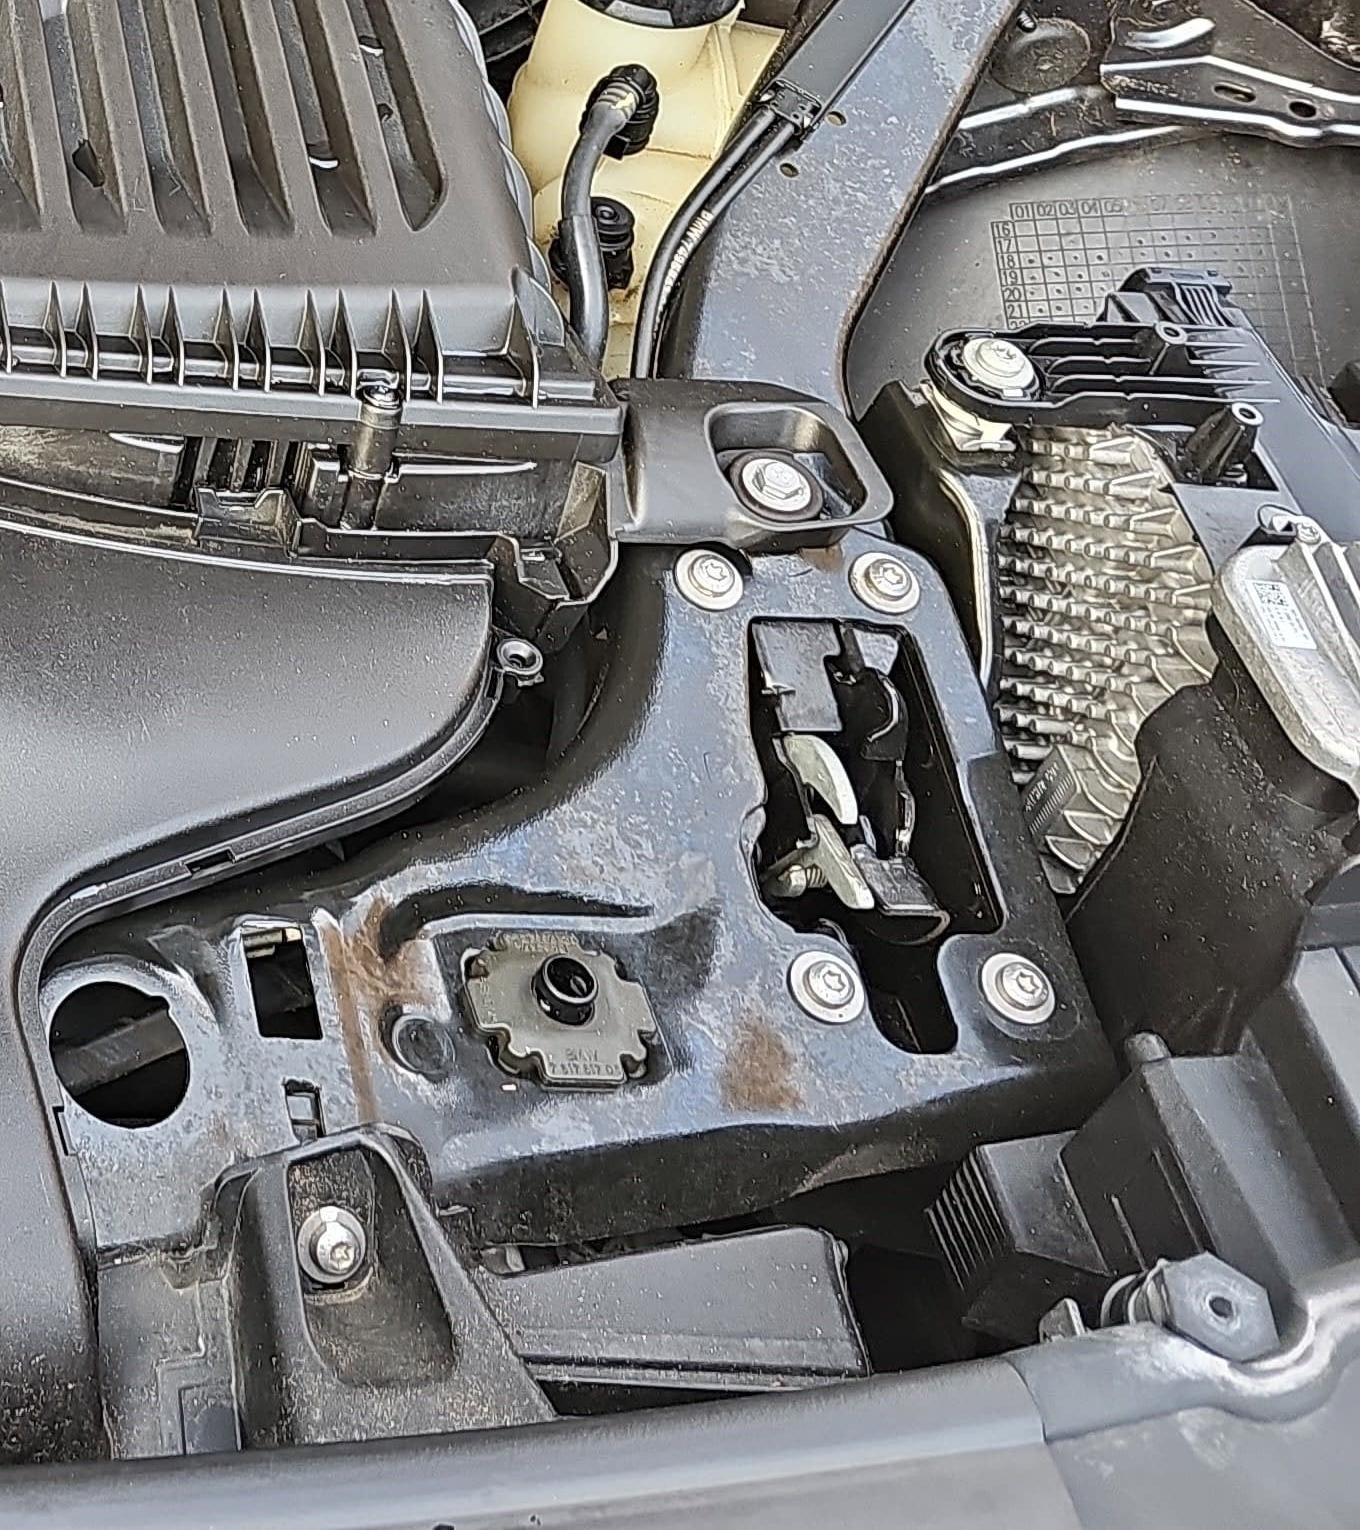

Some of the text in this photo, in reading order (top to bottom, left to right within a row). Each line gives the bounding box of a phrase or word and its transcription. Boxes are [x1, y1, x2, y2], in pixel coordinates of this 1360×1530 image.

[1015, 205, 1031, 218] 01
[1037, 204, 1055, 216] 02
[1059, 200, 1077, 215] 03
[1082, 200, 1099, 214] 04
[686, 210, 713, 241] BMW
[996, 223, 1011, 237] 16
[998, 239, 1011, 254] 17
[1001, 255, 1016, 269] 18
[1003, 270, 1018, 285] 19
[1004, 287, 1022, 302] 20
[1007, 304, 1023, 318] 21
